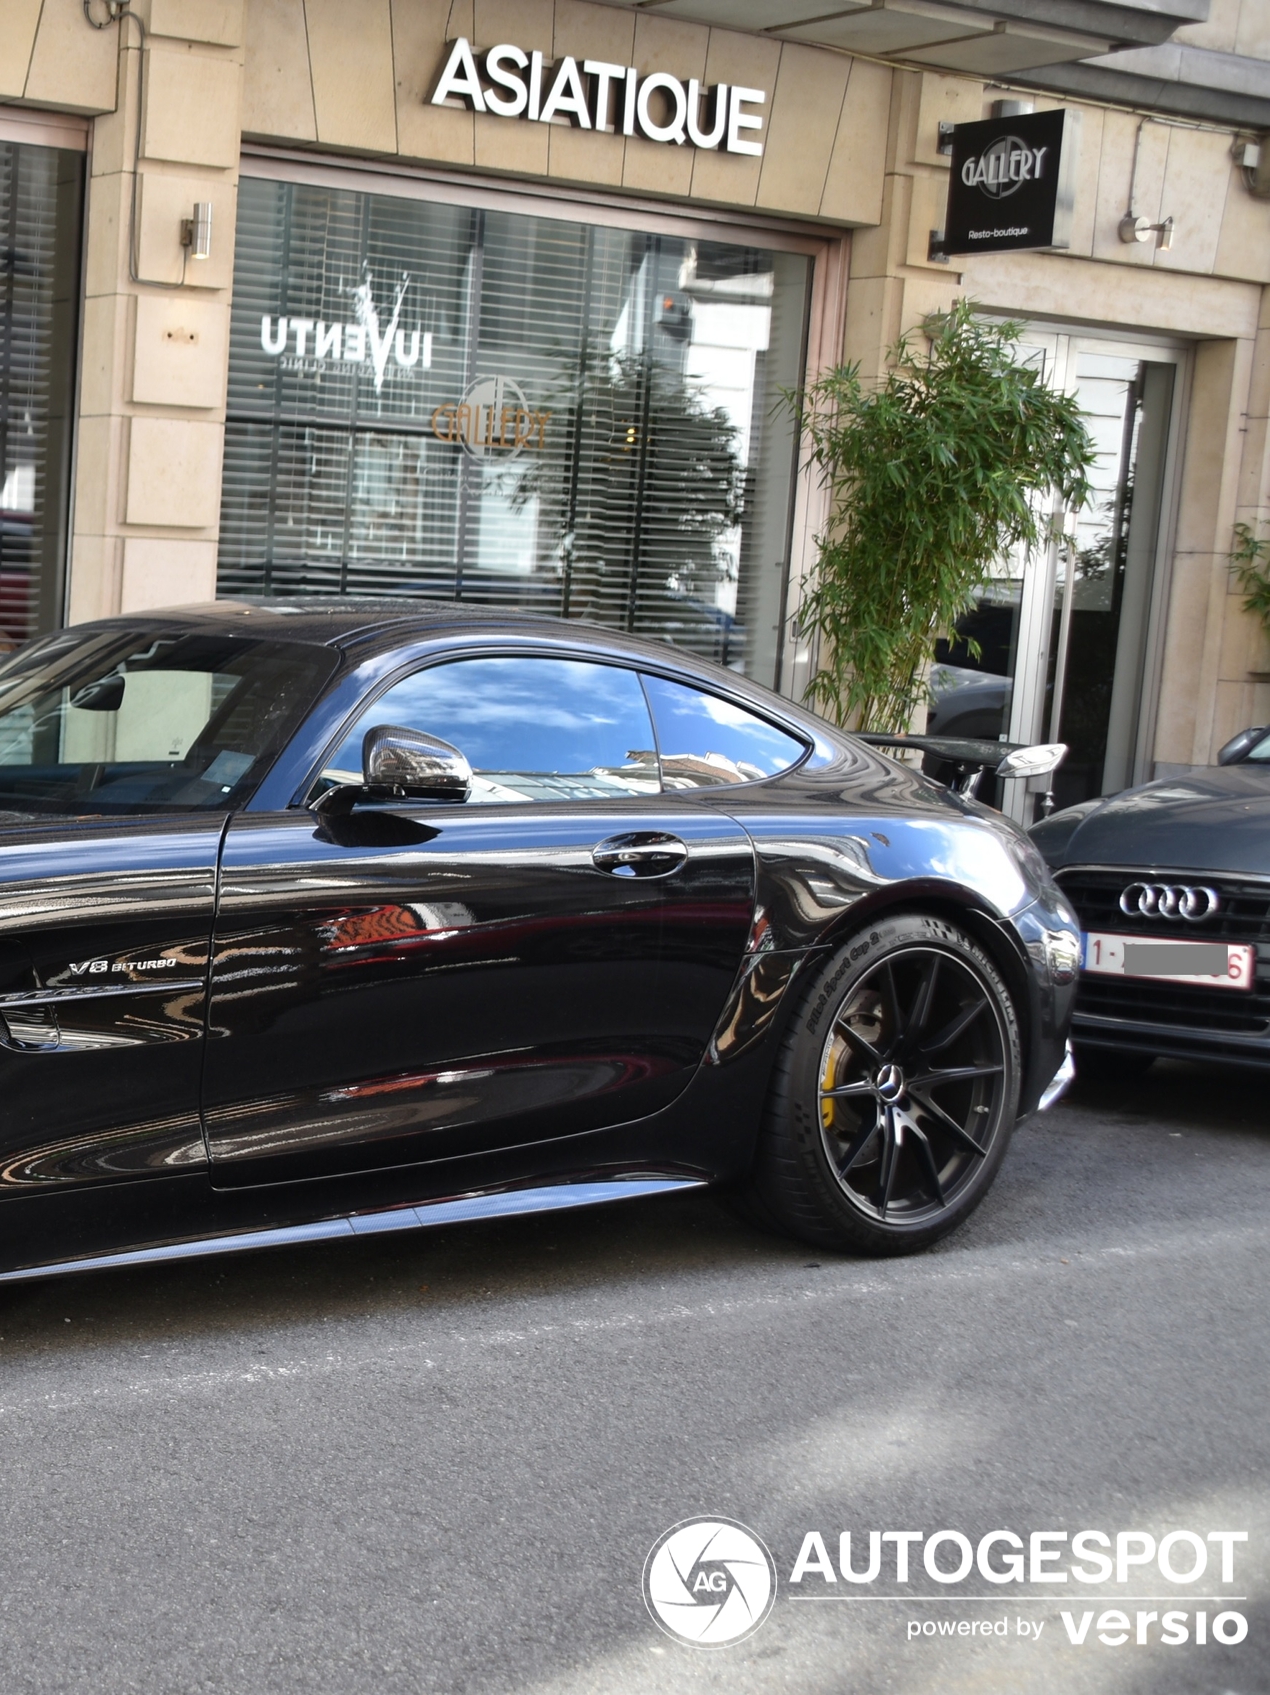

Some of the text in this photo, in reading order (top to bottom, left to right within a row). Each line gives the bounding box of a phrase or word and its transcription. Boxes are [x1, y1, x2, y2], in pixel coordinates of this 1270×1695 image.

[431, 37, 766, 157] ASIATIQUE
[961, 147, 1047, 187] GALLERY
[968, 226, 1028, 240] Resto-boutique
[431, 402, 553, 450] GALLERY
[849, 941, 874, 962] Cup
[869, 931, 880, 946] 2
[69, 958, 177, 975] V8 BITURBO
